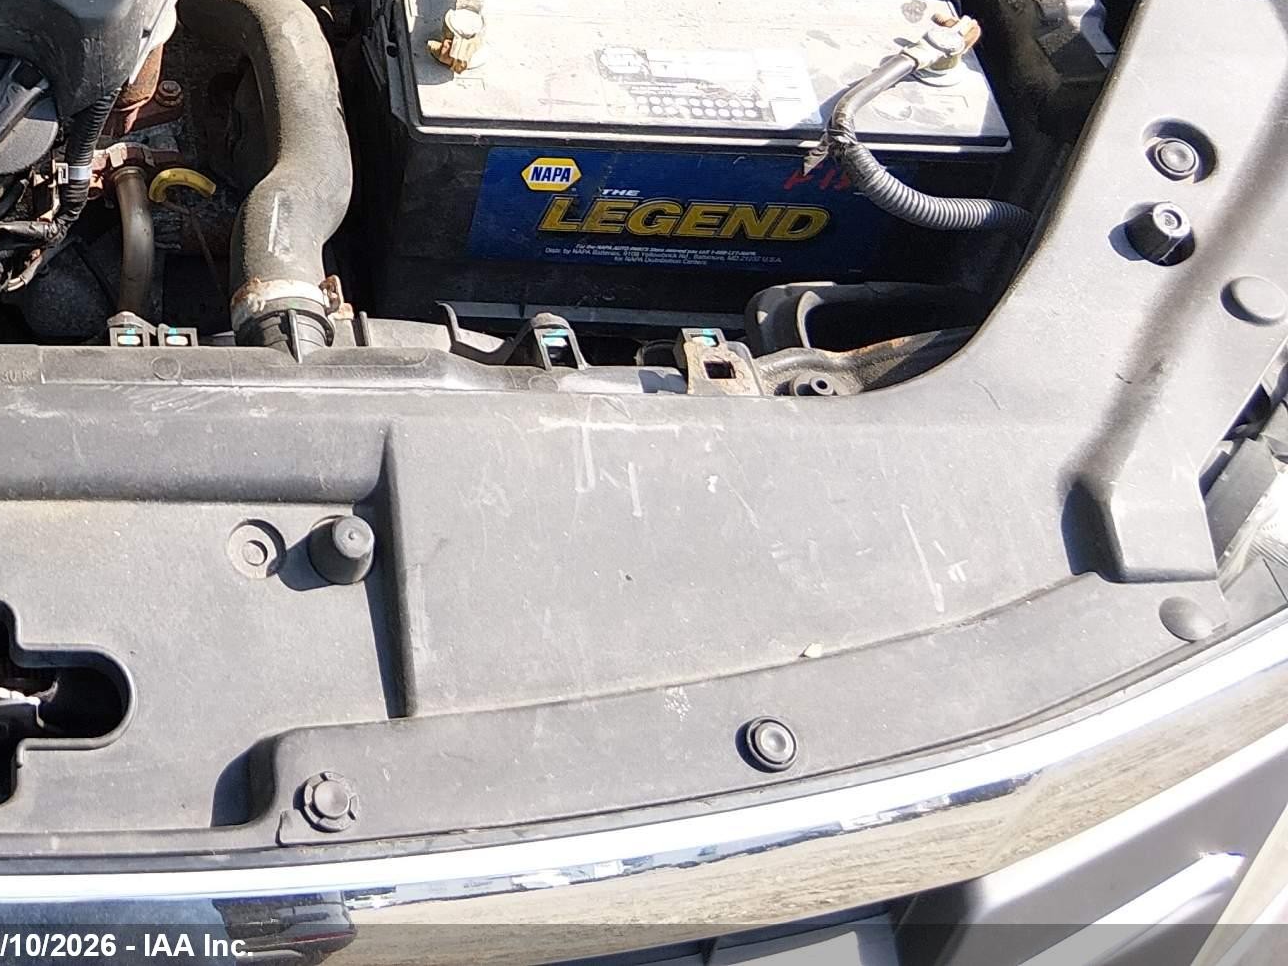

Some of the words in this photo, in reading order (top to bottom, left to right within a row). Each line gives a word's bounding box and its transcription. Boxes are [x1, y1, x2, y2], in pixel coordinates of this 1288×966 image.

[530, 166, 572, 183] NAPA
[602, 189, 641, 197] THE
[536, 195, 832, 241] LEGEND
